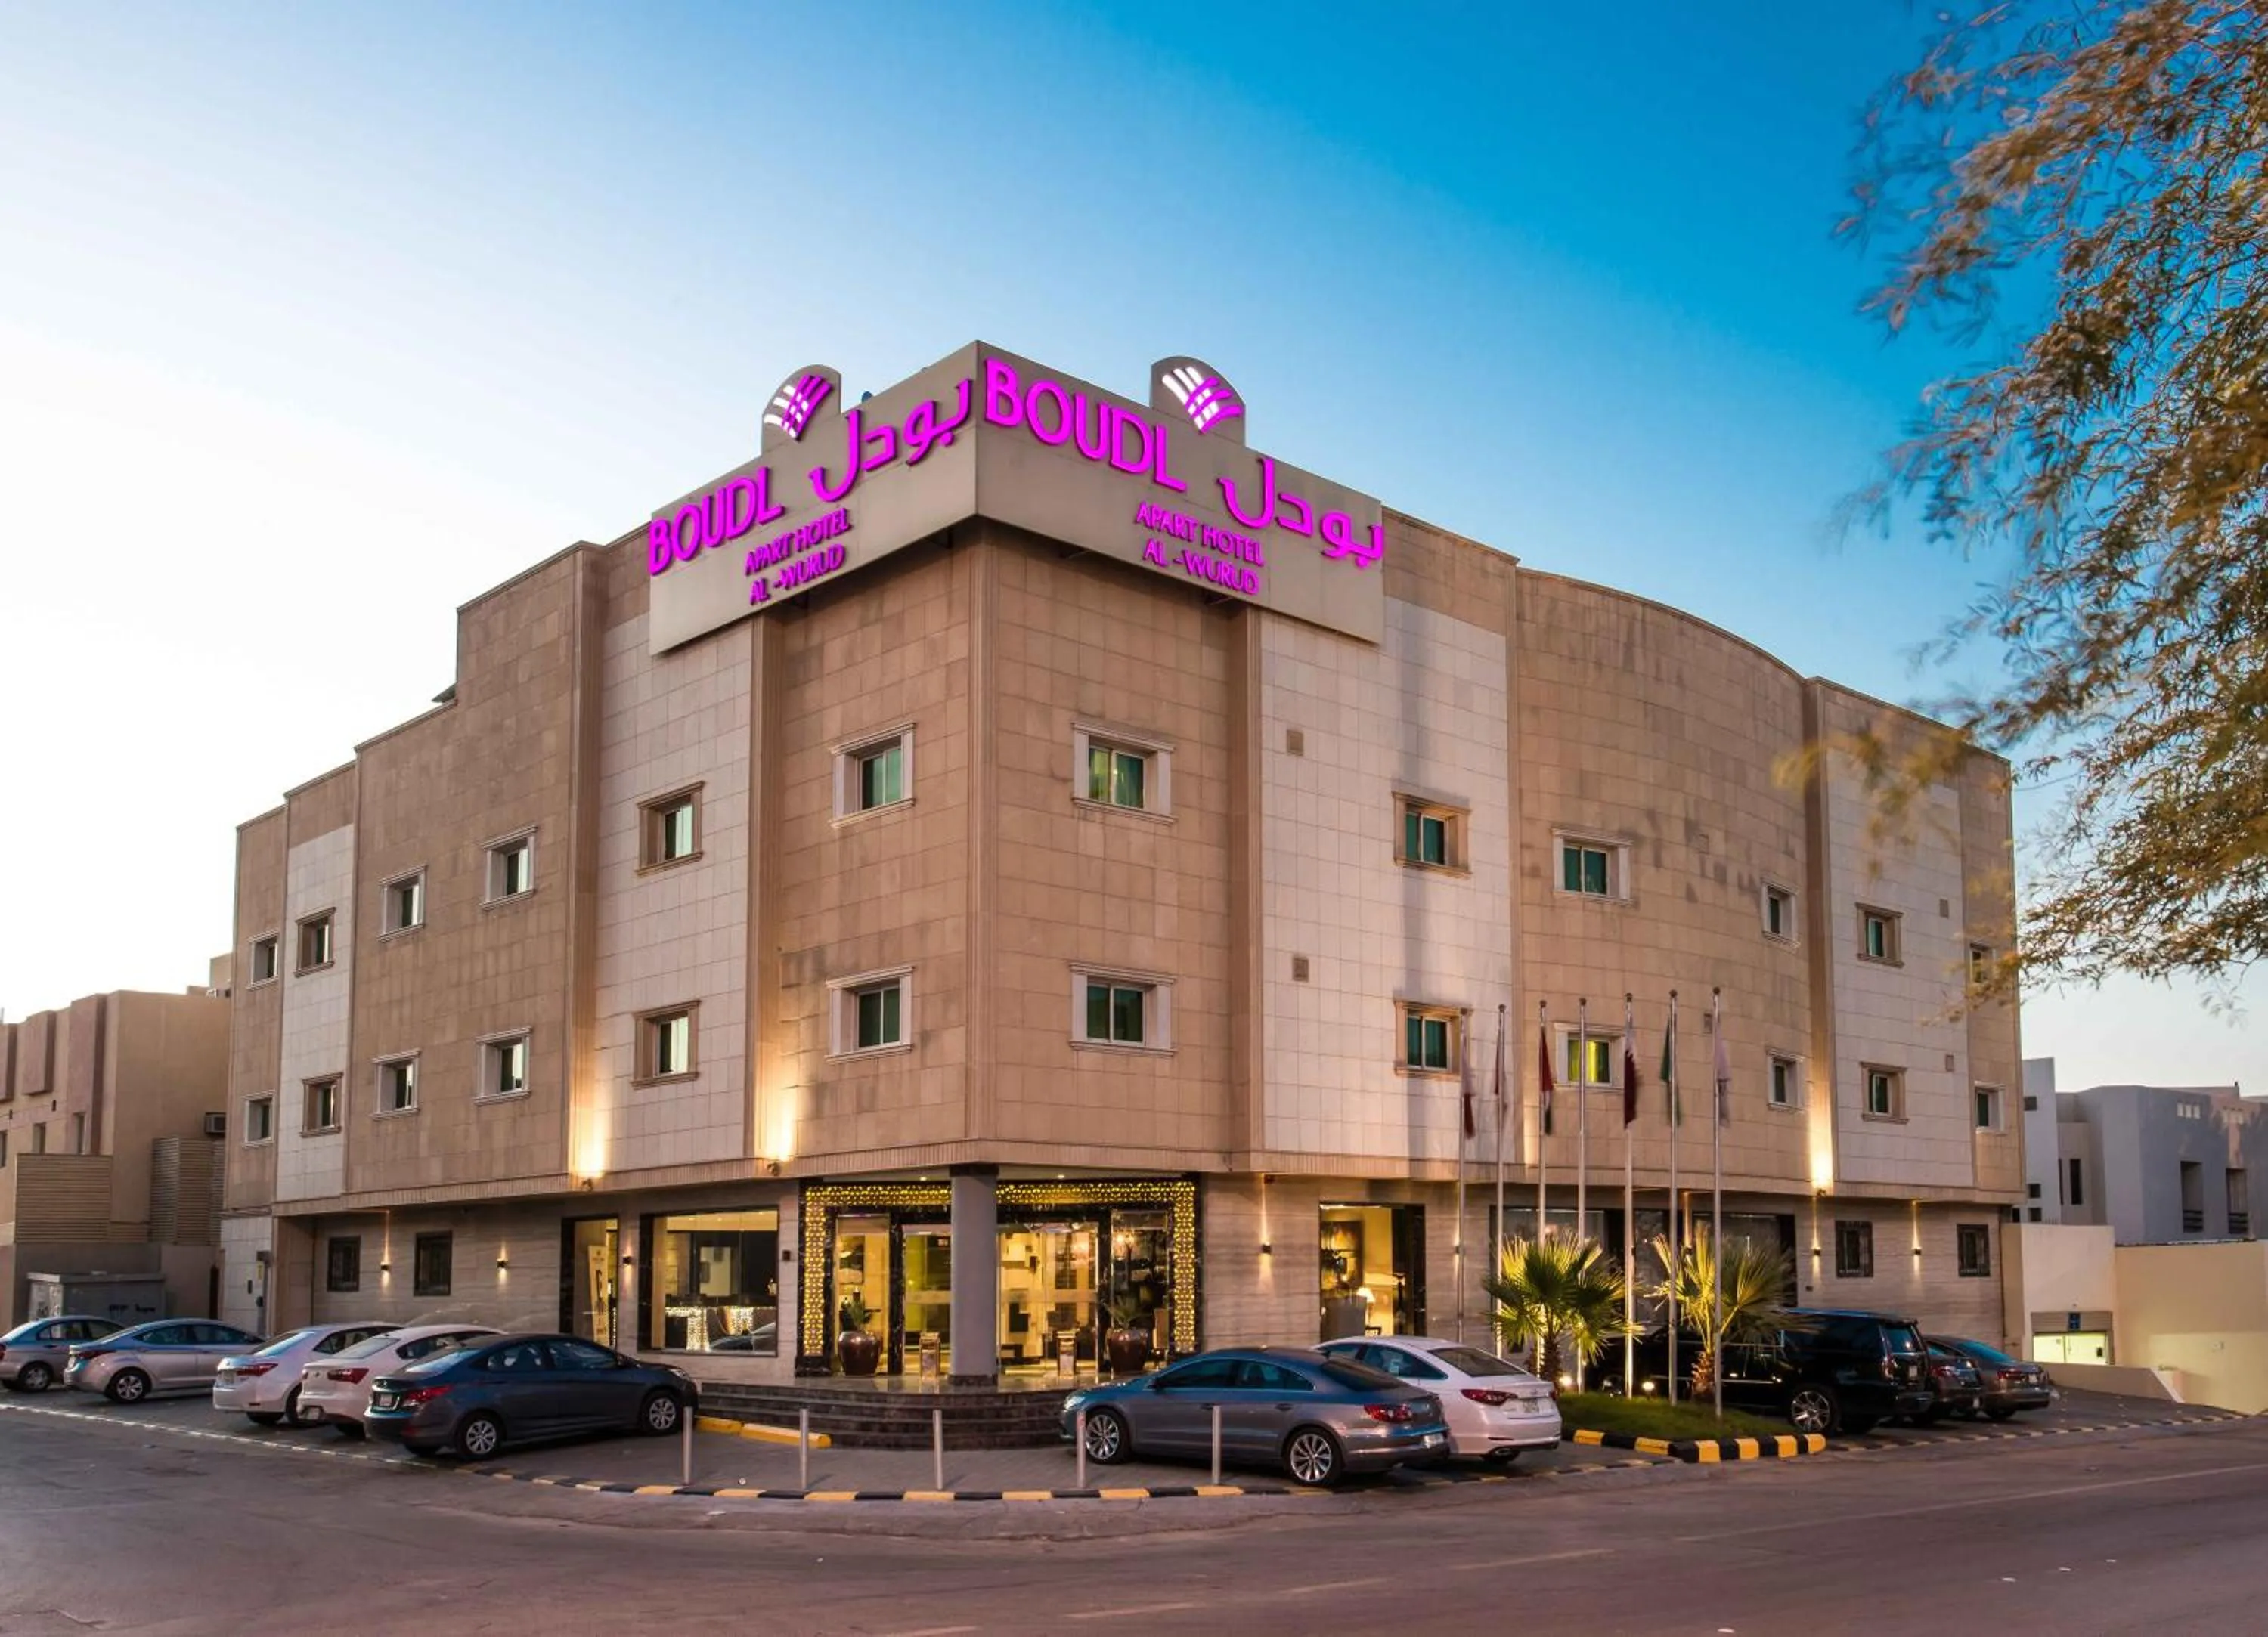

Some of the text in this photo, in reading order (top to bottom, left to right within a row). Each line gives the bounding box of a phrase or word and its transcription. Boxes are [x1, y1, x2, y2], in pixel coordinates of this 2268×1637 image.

[807, 377, 973, 503] بودل
[983, 356, 1188, 494] BOUDL
[647, 465, 785, 577] BOUDL
[744, 507, 852, 577] APART HOTEL
[1135, 500, 1266, 567] APART HOTEL
[1216, 457, 1386, 570] بودل
